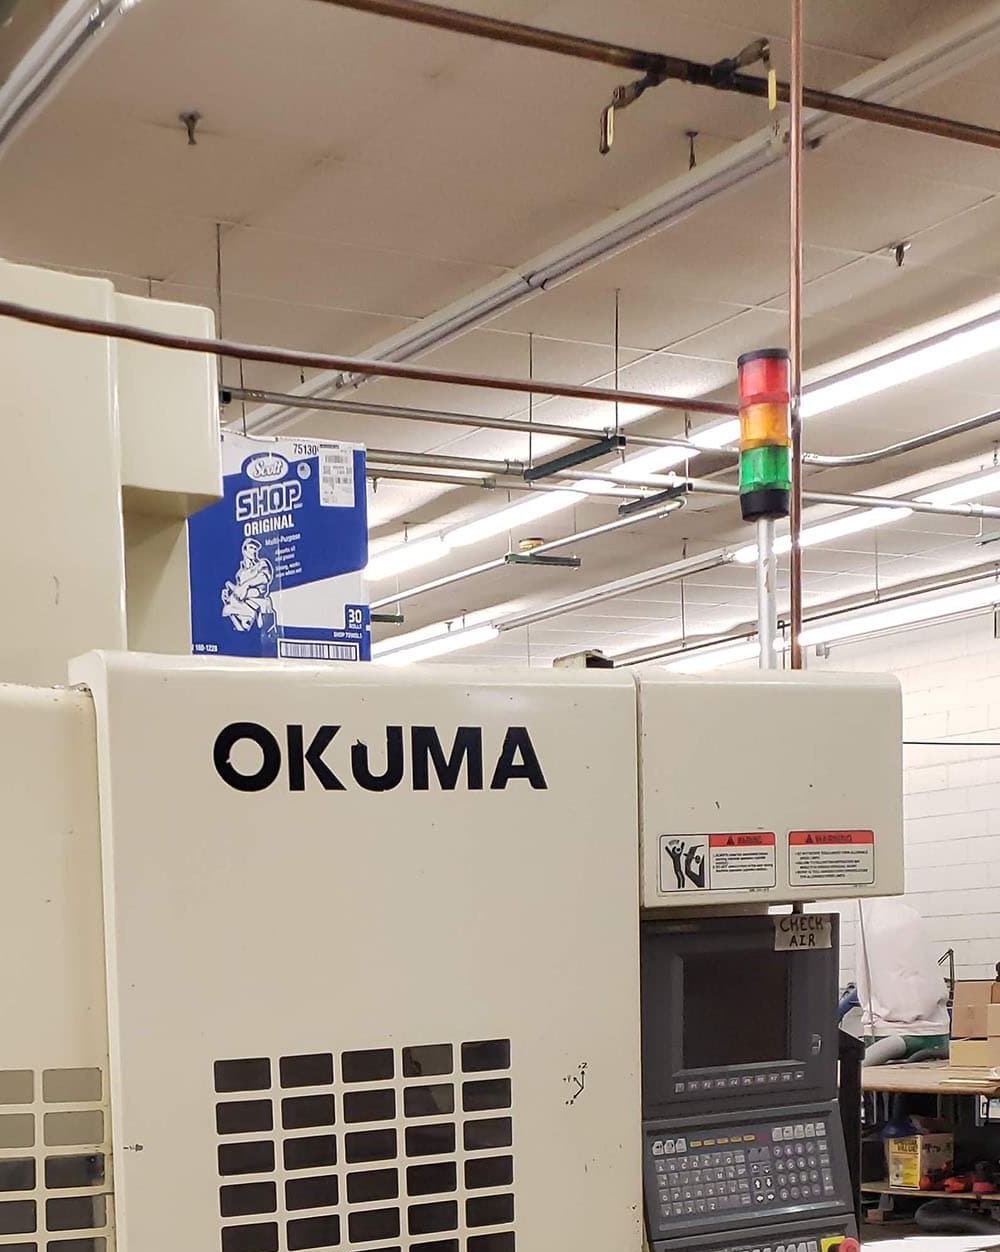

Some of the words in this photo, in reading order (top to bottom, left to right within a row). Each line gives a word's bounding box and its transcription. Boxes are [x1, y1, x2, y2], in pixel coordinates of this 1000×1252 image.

[253, 461, 284, 478] Scott
[236, 480, 301, 521] SHOP
[244, 514, 294, 537] ORIGINAL
[348, 609, 362, 624] 30
[213, 721, 549, 793] OKUMA
[779, 915, 824, 933] CHECK
[789, 933, 816, 947] AIR
